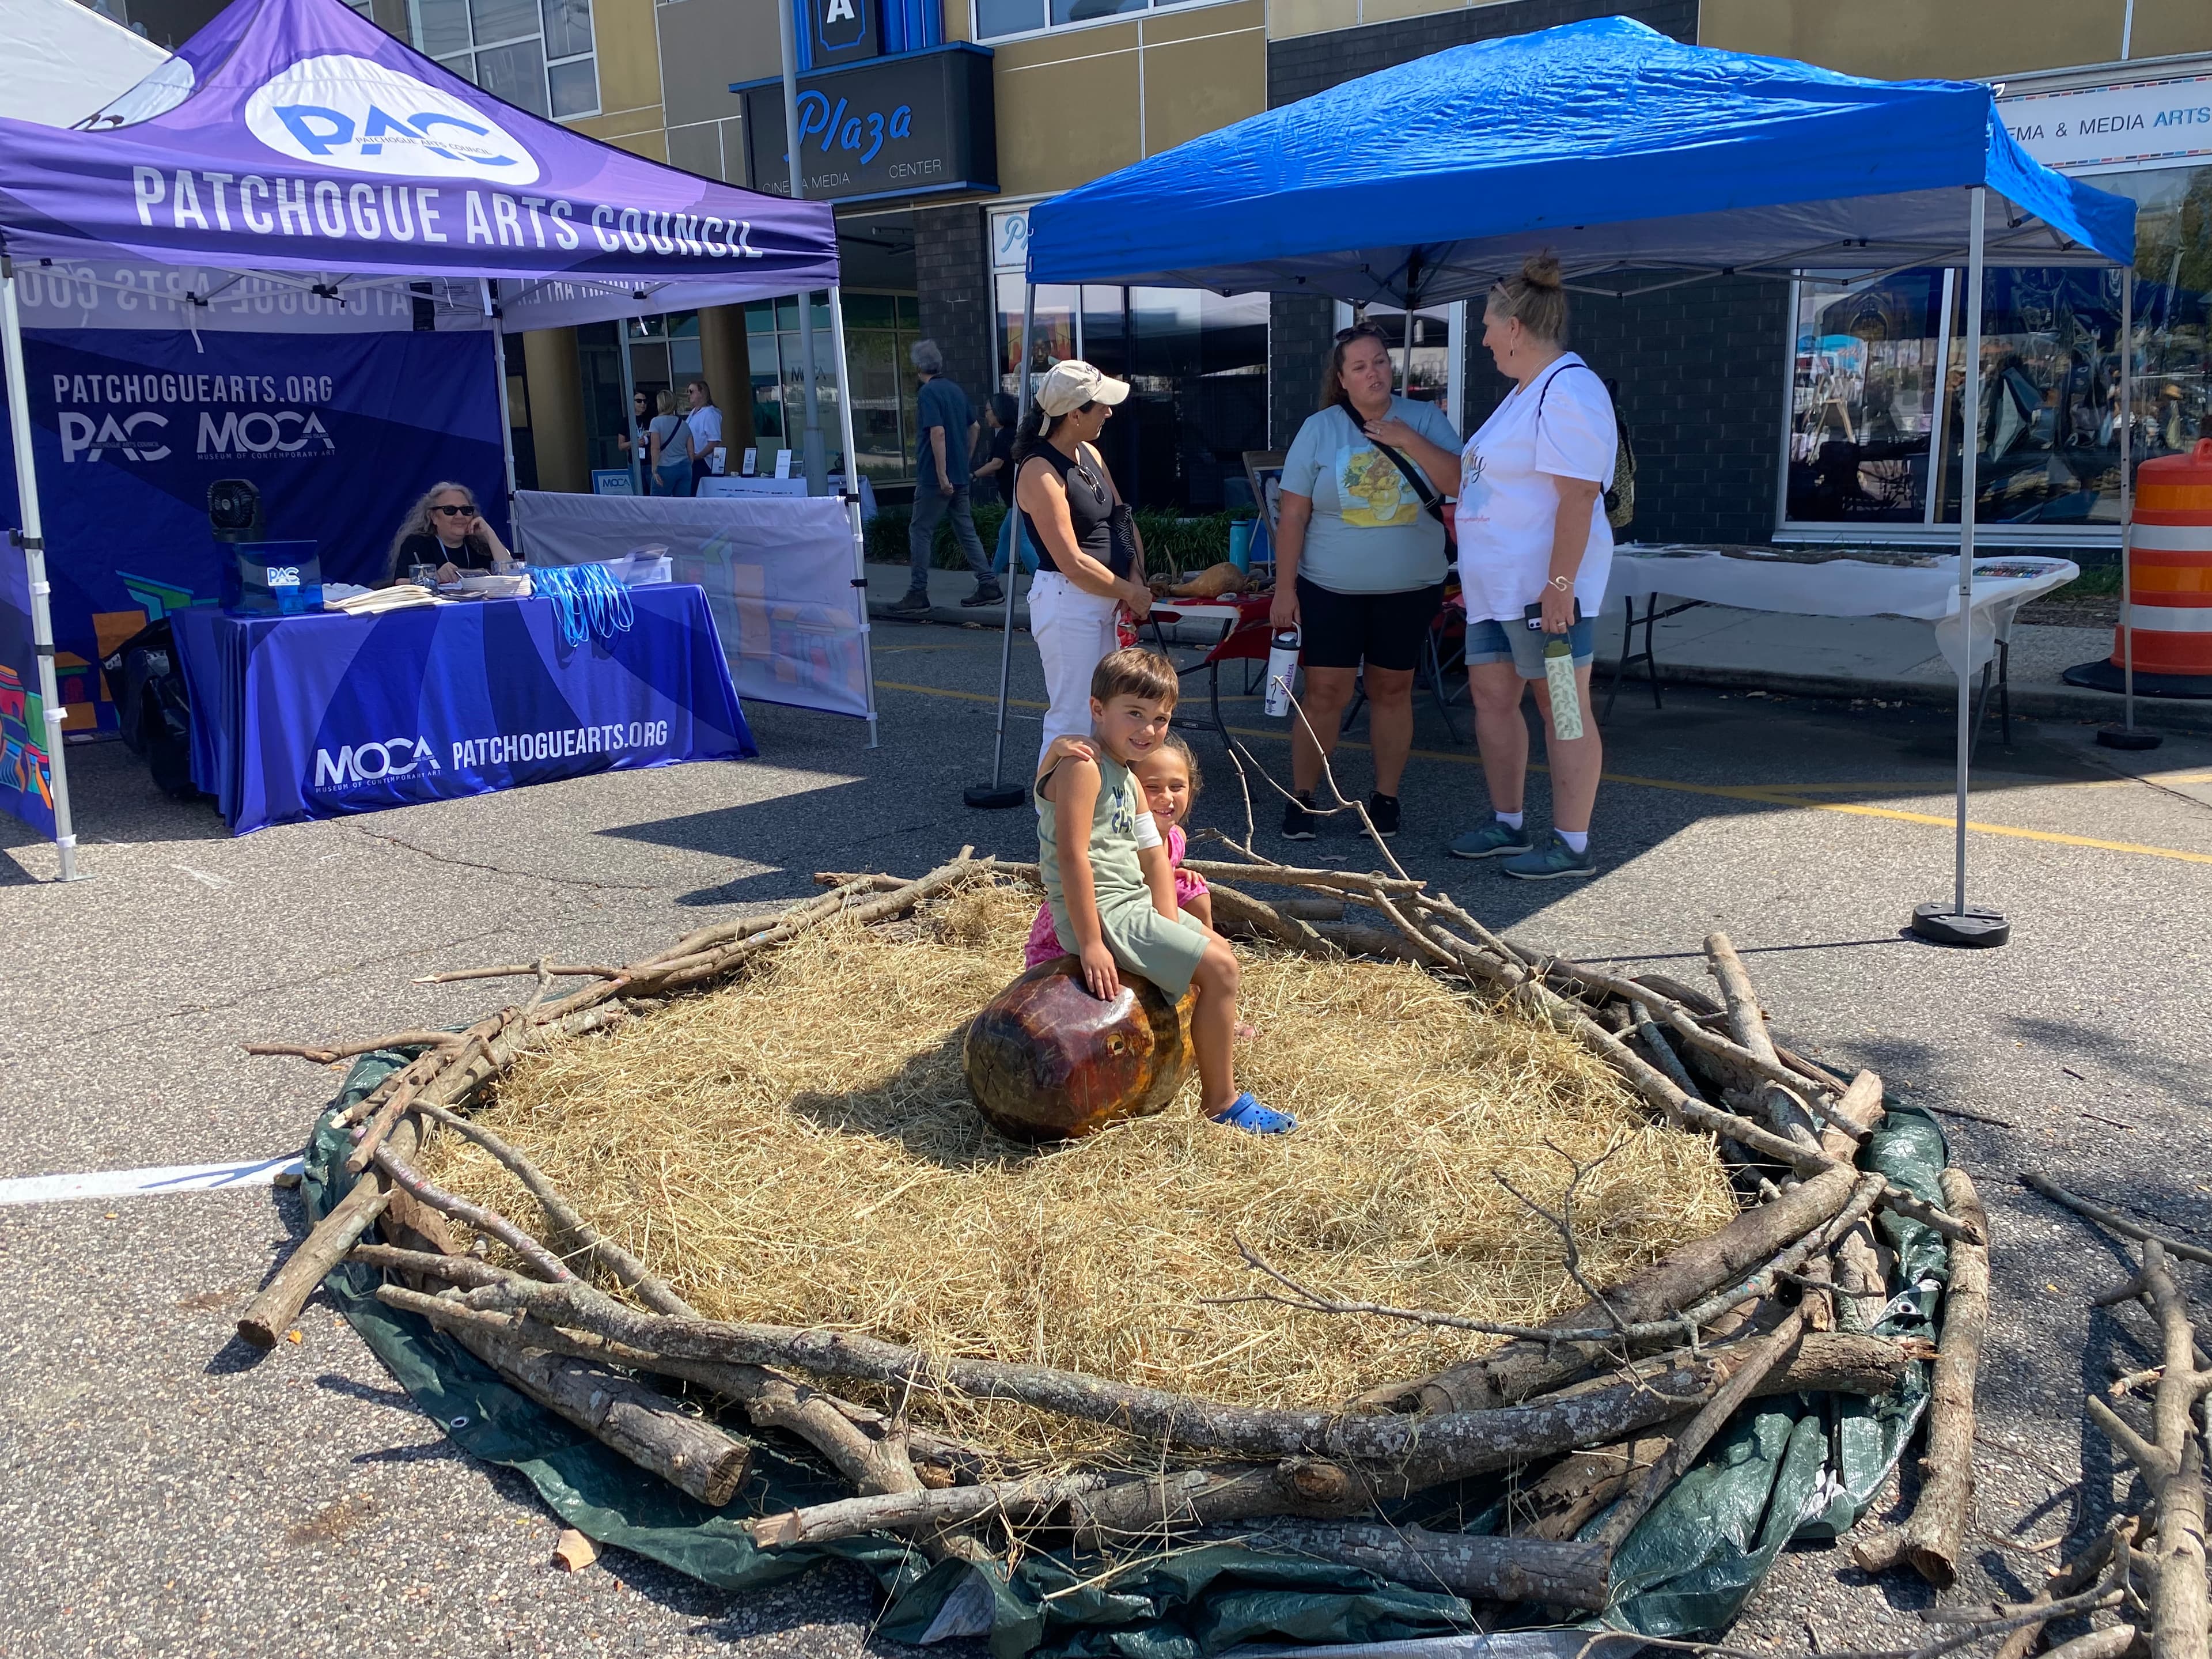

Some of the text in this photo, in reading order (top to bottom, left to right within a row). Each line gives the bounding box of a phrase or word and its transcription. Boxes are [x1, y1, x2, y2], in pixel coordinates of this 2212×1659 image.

[272, 103, 518, 166] PAC
[783, 90, 912, 165] Plaza
[2055, 122, 2068, 137] &
[2079, 114, 2145, 135] MEDIA
[2152, 107, 2211, 128] ARTS
[355, 137, 493, 156] PATCHOGUE ARTS COUNCIL
[762, 159, 942, 194] CINEA MEDIA CENTER
[132, 165, 763, 258] PATCHOGUE ARTS COUNCIL
[791, 365, 827, 382] MA
[53, 374, 333, 403] PATCHOGUEARTS.ORG
[58, 411, 336, 463] PAC MOCA
[251, 451, 317, 459] CONTEMPORARY
[603, 478, 630, 487] MOCA
[267, 567, 300, 584] PAC
[314, 720, 668, 787] MOCA PATCHOGUEARTS.ORG
[316, 783, 348, 793] MUSEUM
[366, 772, 425, 786] CONTEMPORARY
